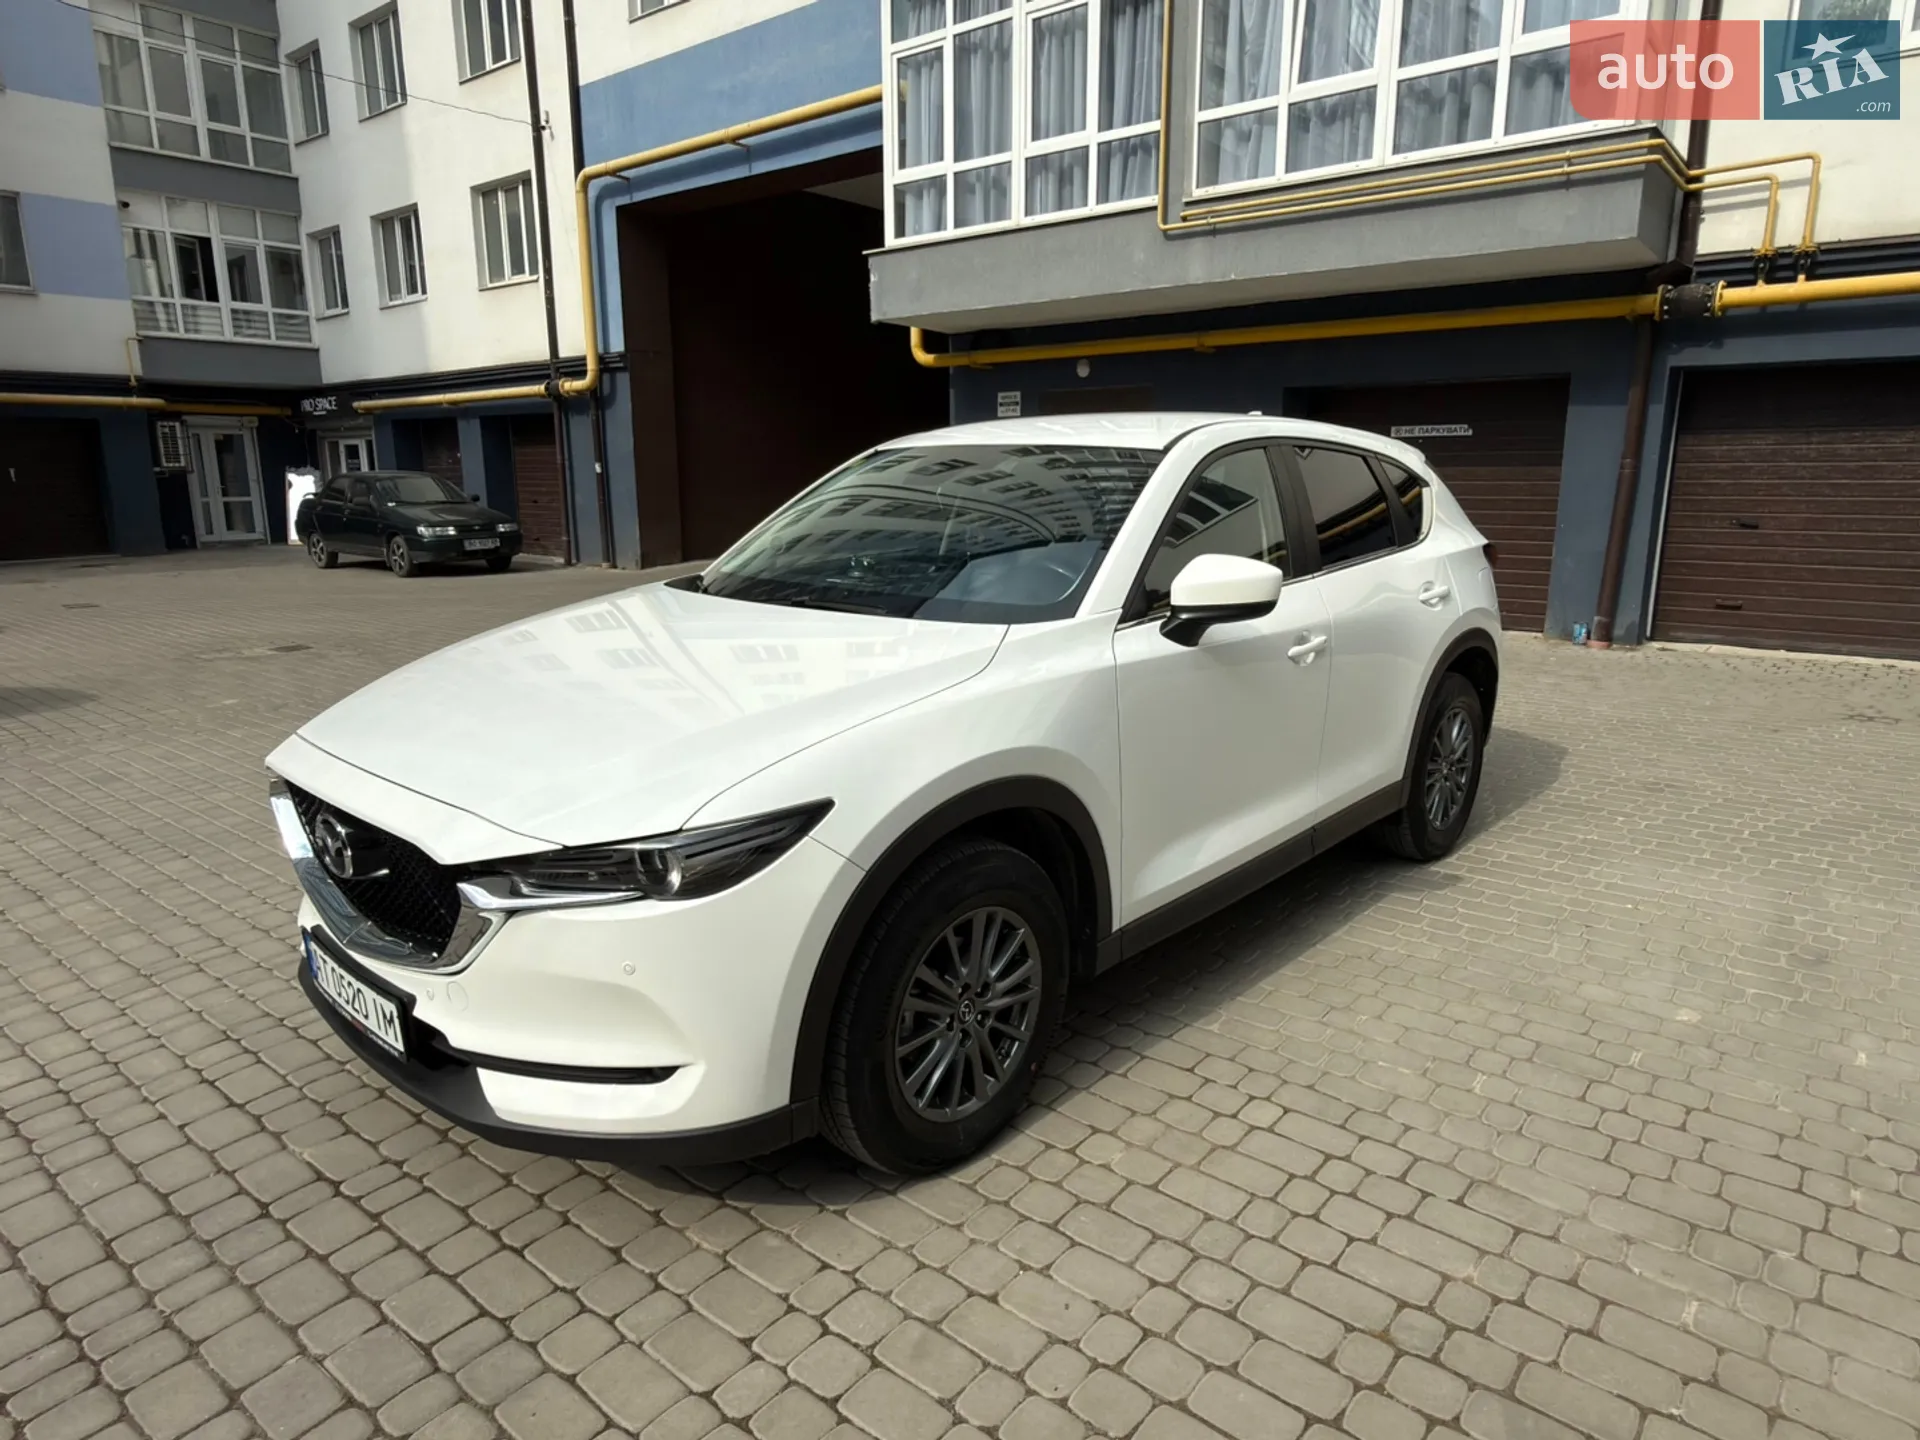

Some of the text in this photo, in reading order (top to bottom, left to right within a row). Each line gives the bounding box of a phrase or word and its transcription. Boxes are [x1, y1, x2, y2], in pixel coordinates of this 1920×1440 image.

[315, 396, 338, 411] SPACE
[1404, 427, 1416, 435] НЕ
[331, 966, 369, 1021] 0520
[372, 997, 399, 1043] IM
